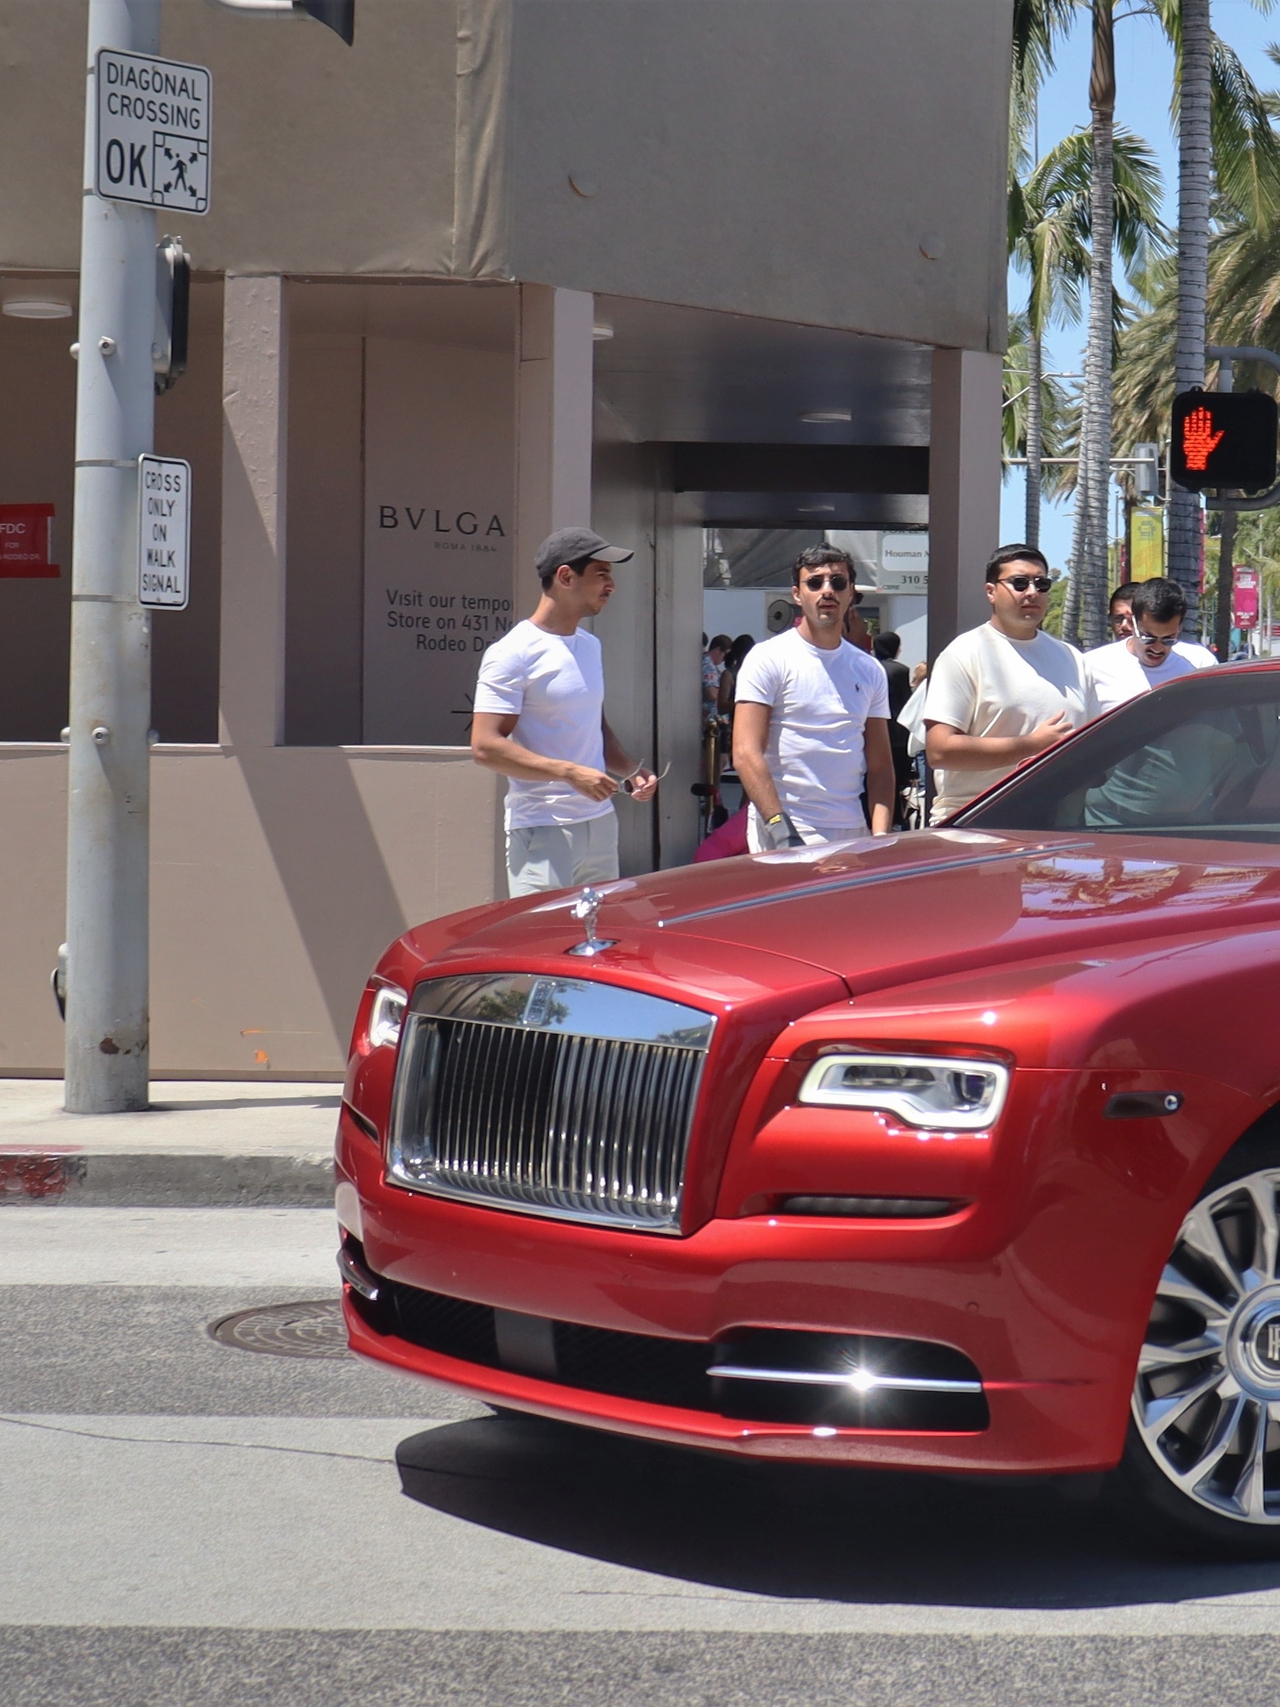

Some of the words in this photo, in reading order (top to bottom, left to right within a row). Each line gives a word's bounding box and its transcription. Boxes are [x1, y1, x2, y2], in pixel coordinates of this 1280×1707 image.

[107, 61, 202, 102] DIAGONAL
[107, 92, 200, 130] CROSSING
[106, 138, 147, 188] OK
[145, 471, 181, 493] CROSS
[147, 497, 175, 517] ONLY
[379, 505, 506, 537] BVLGA
[152, 523, 167, 542] ON
[434, 541, 467, 551] ROMA
[471, 543, 497, 552] 1884
[885, 550, 923, 558] Houman
[146, 548, 176, 568] WALK
[142, 573, 181, 594] SIGNAL
[900, 575, 921, 585] 310
[386, 588, 424, 608] Visit
[429, 594, 456, 609] our
[387, 610, 431, 629] Store
[436, 616, 456, 630] on
[461, 614, 489, 631] 431
[416, 633, 467, 652] Rodeo
